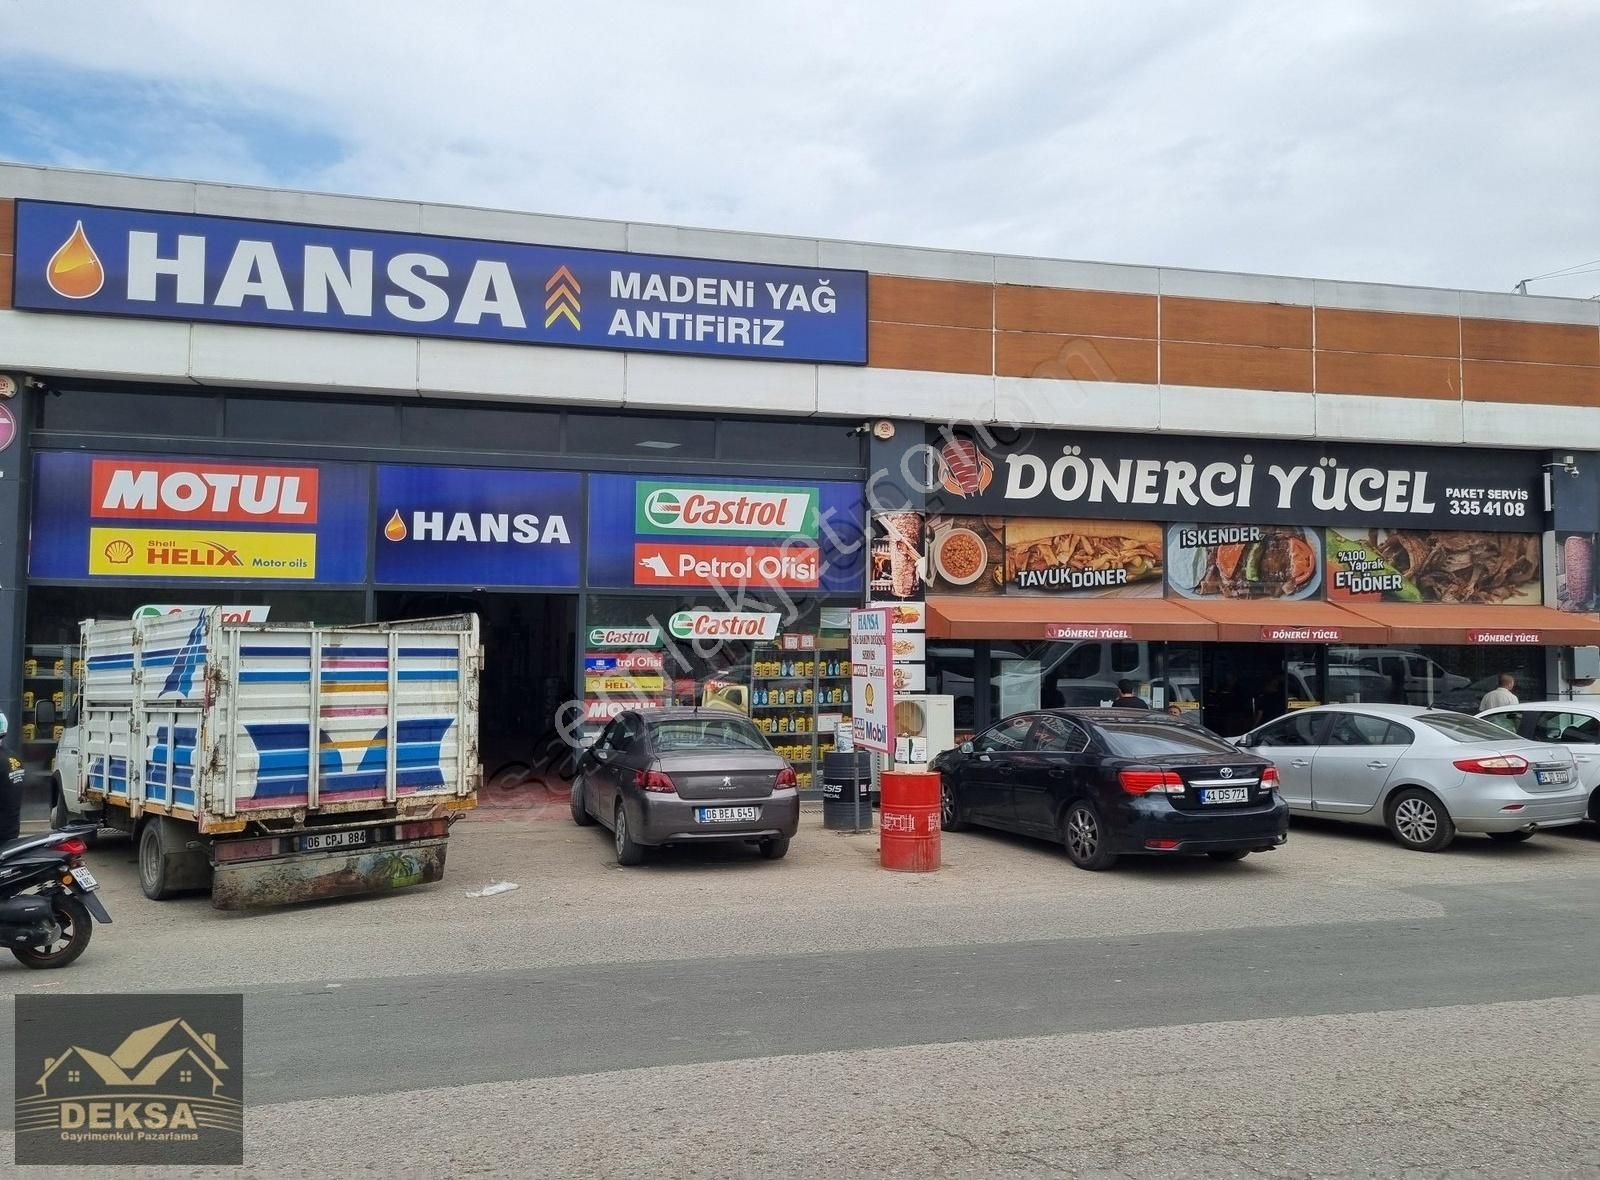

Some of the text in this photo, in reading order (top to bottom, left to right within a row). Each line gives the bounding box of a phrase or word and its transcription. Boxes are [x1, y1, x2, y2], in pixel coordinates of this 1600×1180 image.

[127, 230, 527, 328] HANSA
[765, 279, 837, 314] YAĞ
[1004, 445, 1435, 514] DÖNERCİ YÜCEL
[102, 470, 308, 515] MOTUL
[1446, 488, 1485, 499] PAKET
[683, 494, 788, 526] Castrol
[1449, 500, 1481, 515] 335
[412, 511, 571, 544] HANSA
[147, 548, 242, 566] HELIX
[252, 558, 308, 568] Motor oils
[1338, 550, 1366, 561] %100
[679, 554, 816, 580] Petrol Ofisi
[1349, 560, 1384, 572] Yaprak
[1018, 568, 1127, 588] TAVUK DÖNER
[1336, 572, 1402, 593] ET DÖNER
[694, 614, 767, 636] Castrol
[857, 614, 879, 630] HANSA
[606, 631, 649, 643] Castrol
[1058, 627, 1128, 638] DÖNERCİ YÜCEL
[1272, 629, 1338, 639] DÖNERCİ YÜCEL
[1478, 632, 1539, 642] DÖNERCİ YÜCEL
[615, 656, 635, 667] trol
[637, 657, 662, 667] Ofisi
[865, 721, 887, 744] Mobil
[1206, 789, 1245, 800] 41 DS 771
[706, 807, 753, 819] 06 BEA 645
[308, 831, 365, 848] 06 CPJ 884
